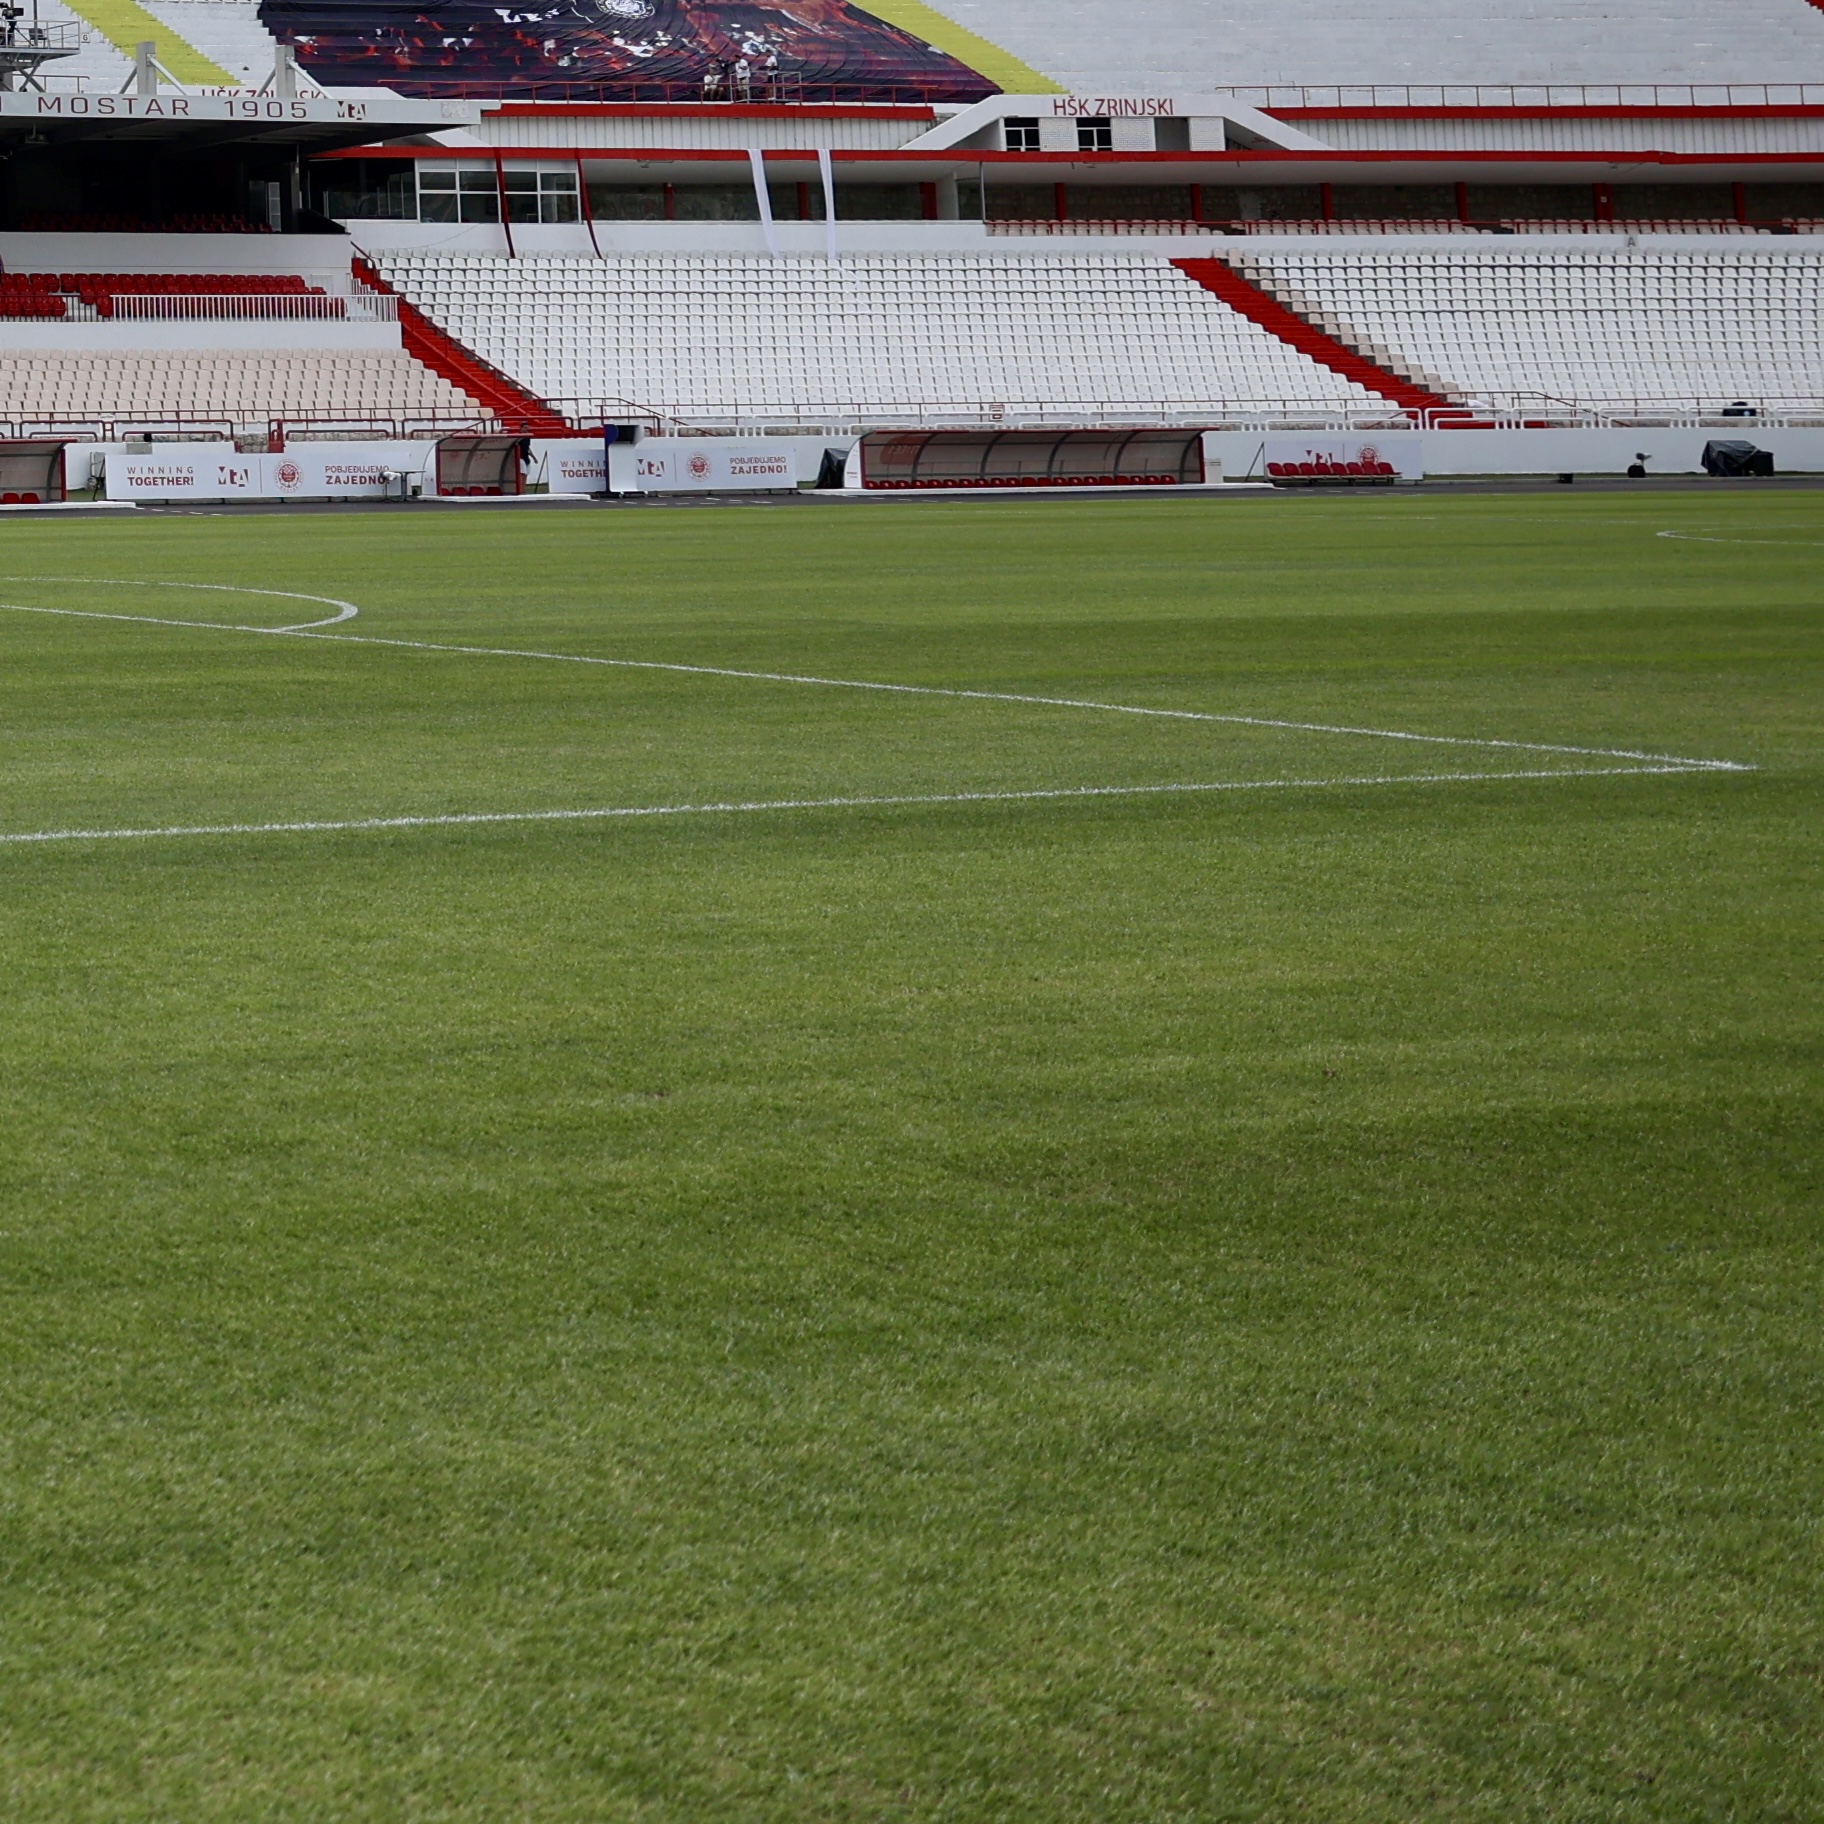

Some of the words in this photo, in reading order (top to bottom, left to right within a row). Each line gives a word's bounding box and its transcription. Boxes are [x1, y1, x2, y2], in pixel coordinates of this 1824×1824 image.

[37, 96, 190, 117] MOSTAR
[224, 99, 308, 119] 1905
[1053, 95, 1091, 116] HŠK
[1094, 97, 1174, 116] ZRINJSKI
[126, 466, 194, 474] WINNING
[731, 465, 788, 475] ZAJEDNO!
[127, 476, 194, 486] TOGETHER!
